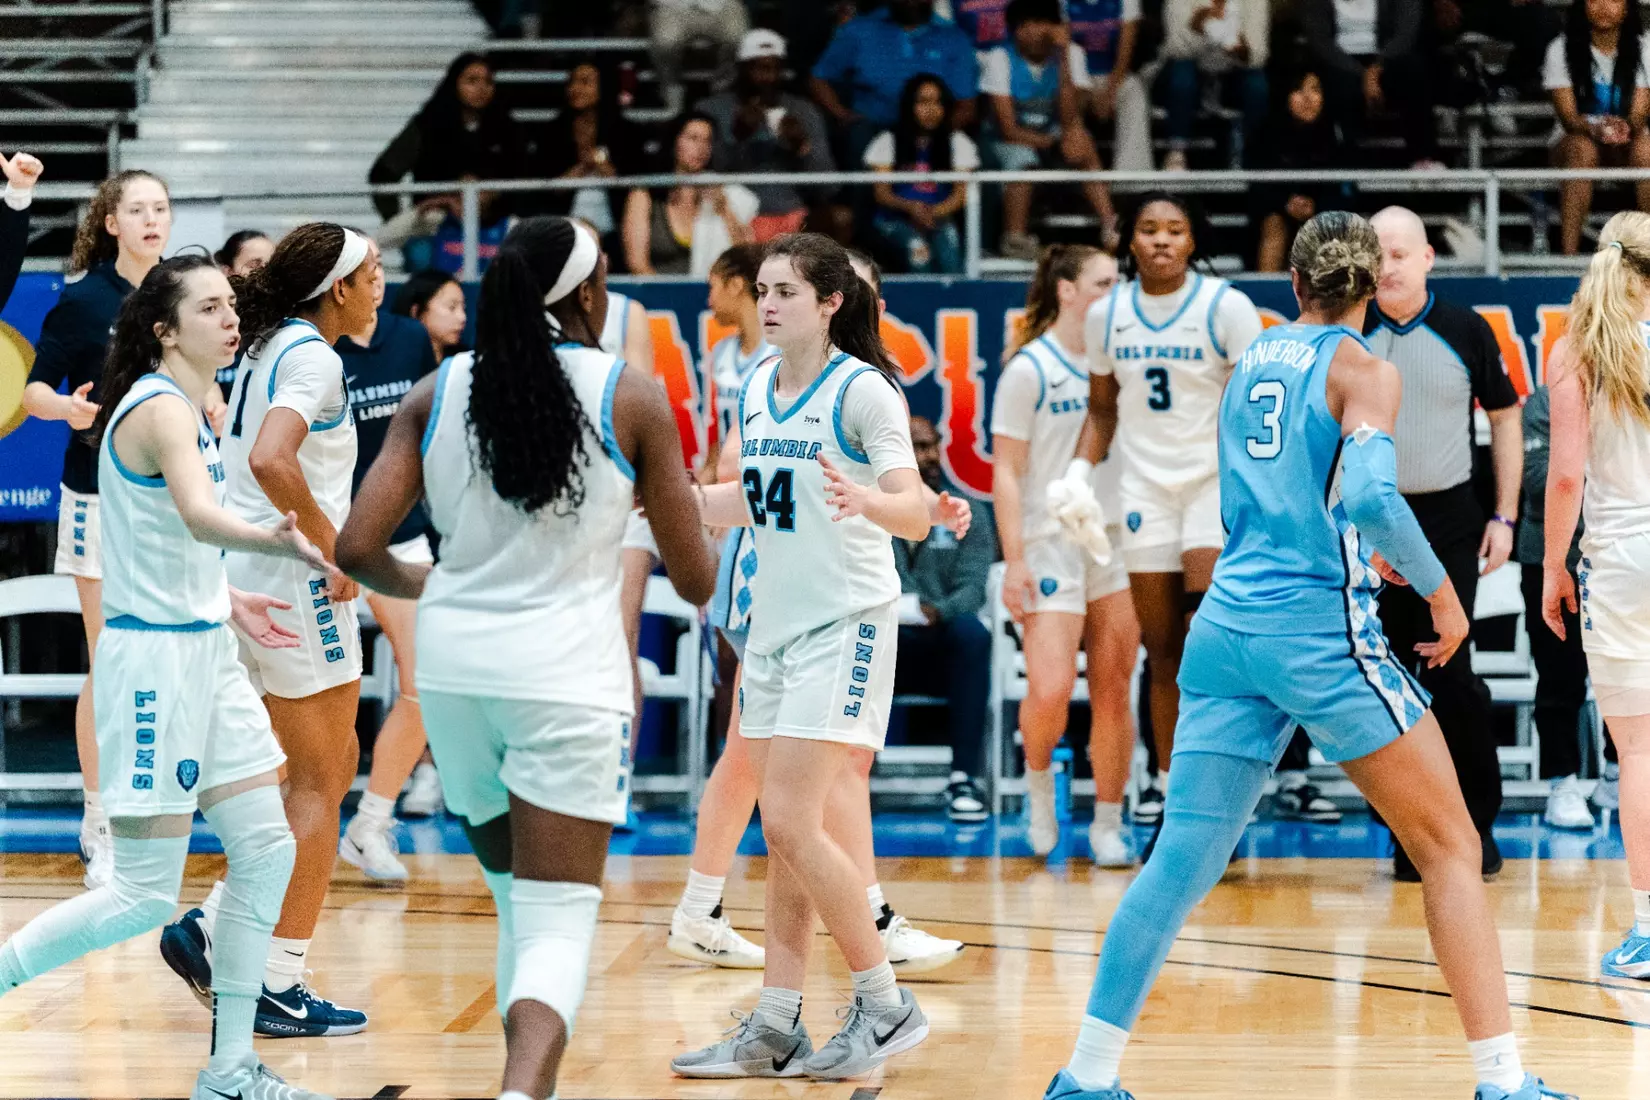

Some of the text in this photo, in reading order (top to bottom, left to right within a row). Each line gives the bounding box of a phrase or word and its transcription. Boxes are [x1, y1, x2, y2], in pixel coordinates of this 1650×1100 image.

[1115, 344, 1204, 361] COLUMBIA
[1242, 339, 1318, 374] HNDERSON
[230, 368, 254, 440] 1
[348, 379, 413, 404] OLUMBIA
[1145, 366, 1172, 412] 3
[1246, 379, 1287, 460] 3
[742, 438, 822, 460] OLUMBIA
[743, 466, 796, 533] 24
[308, 577, 345, 663] LIONS
[844, 622, 876, 718] LIONS
[132, 690, 156, 790] LIONS
